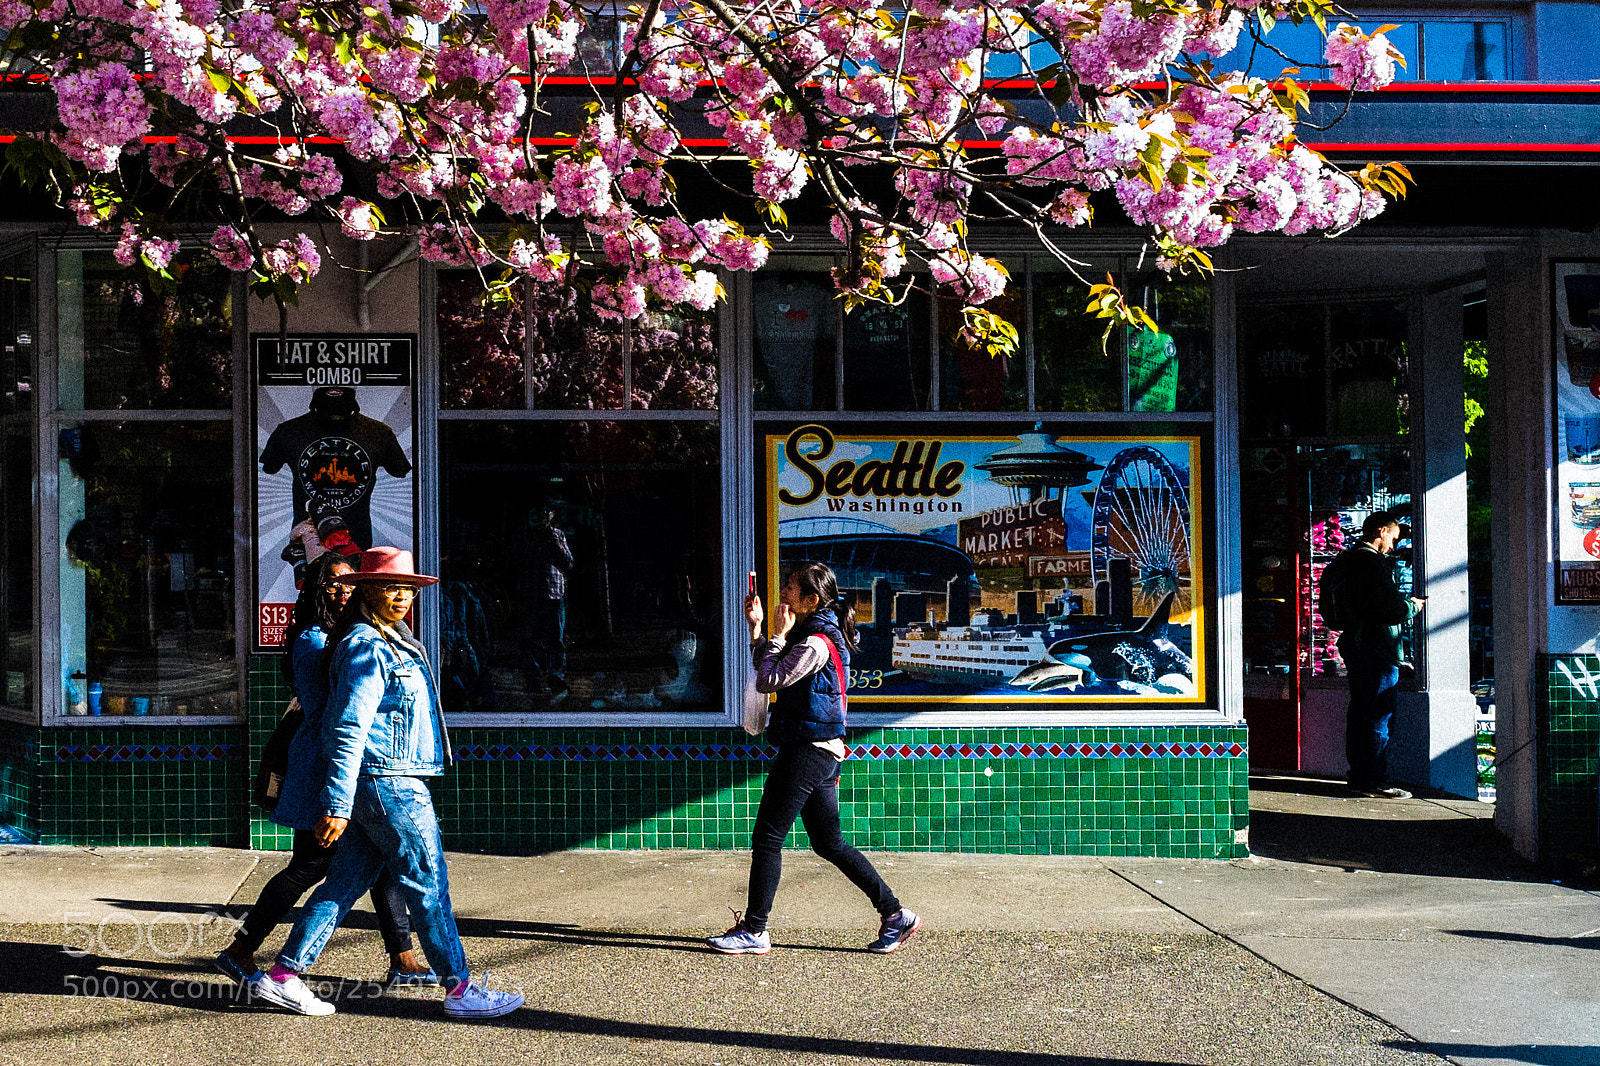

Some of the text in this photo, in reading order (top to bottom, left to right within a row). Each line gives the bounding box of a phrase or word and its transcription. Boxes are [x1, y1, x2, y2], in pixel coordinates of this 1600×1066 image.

[317, 341, 331, 364] &
[334, 342, 392, 364] SHIRT
[306, 367, 362, 385] COMBO
[300, 439, 369, 472] SEATTLE
[778, 423, 967, 507] Seattle
[826, 498, 963, 515] Washington
[981, 498, 1048, 528] PUBLIC
[965, 526, 1036, 554] MARKET
